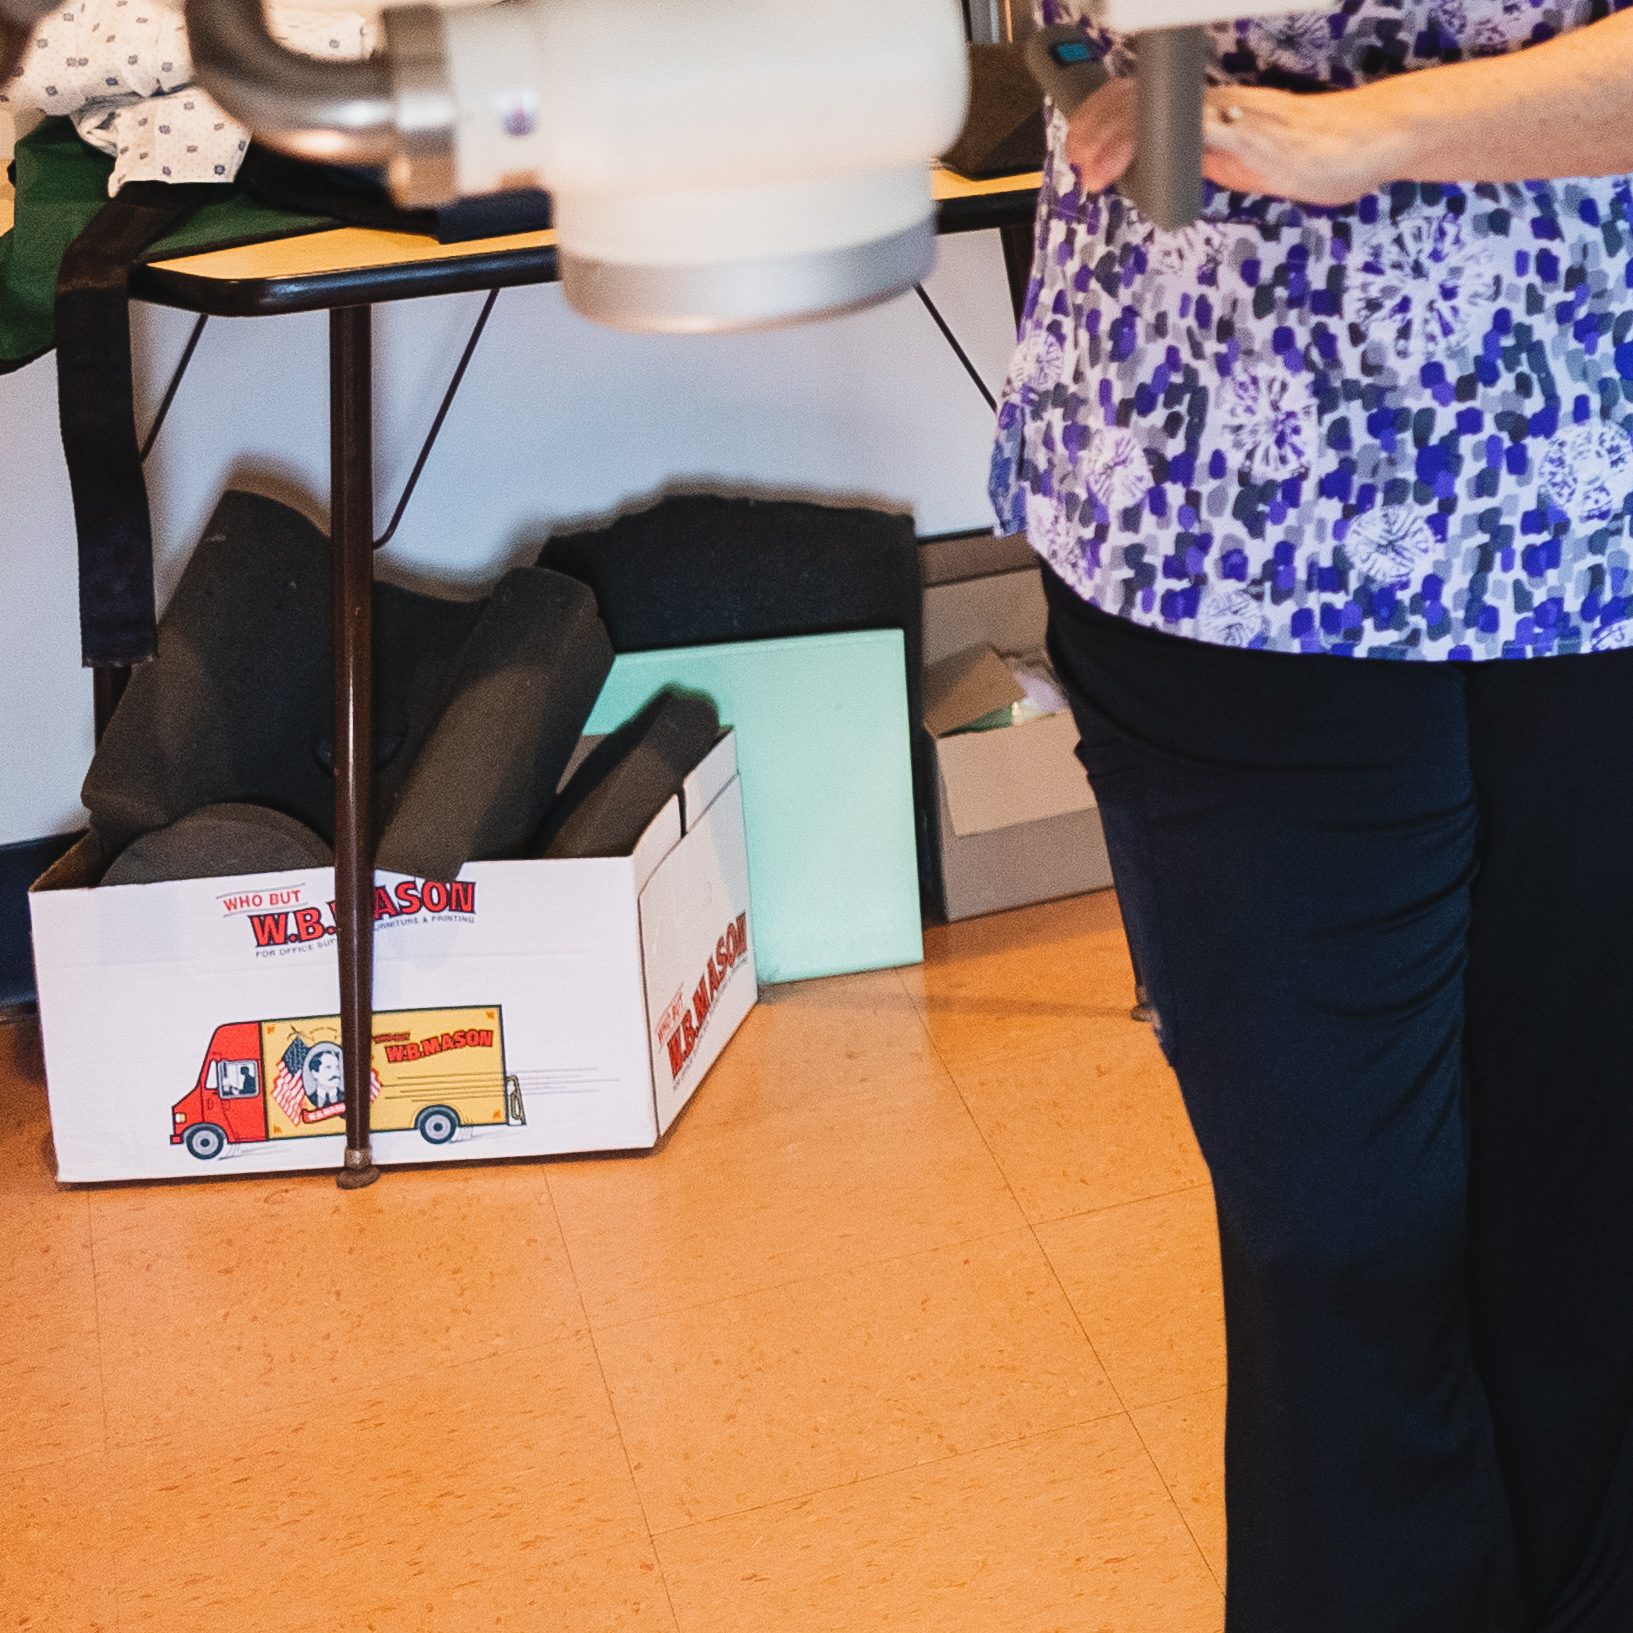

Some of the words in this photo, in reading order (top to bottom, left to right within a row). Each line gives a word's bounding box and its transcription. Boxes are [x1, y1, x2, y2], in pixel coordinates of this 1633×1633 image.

[223, 895, 262, 911] WHO
[269, 889, 301, 906] BUT
[255, 950, 276, 958] FOR
[280, 944, 314, 956] OFFICE
